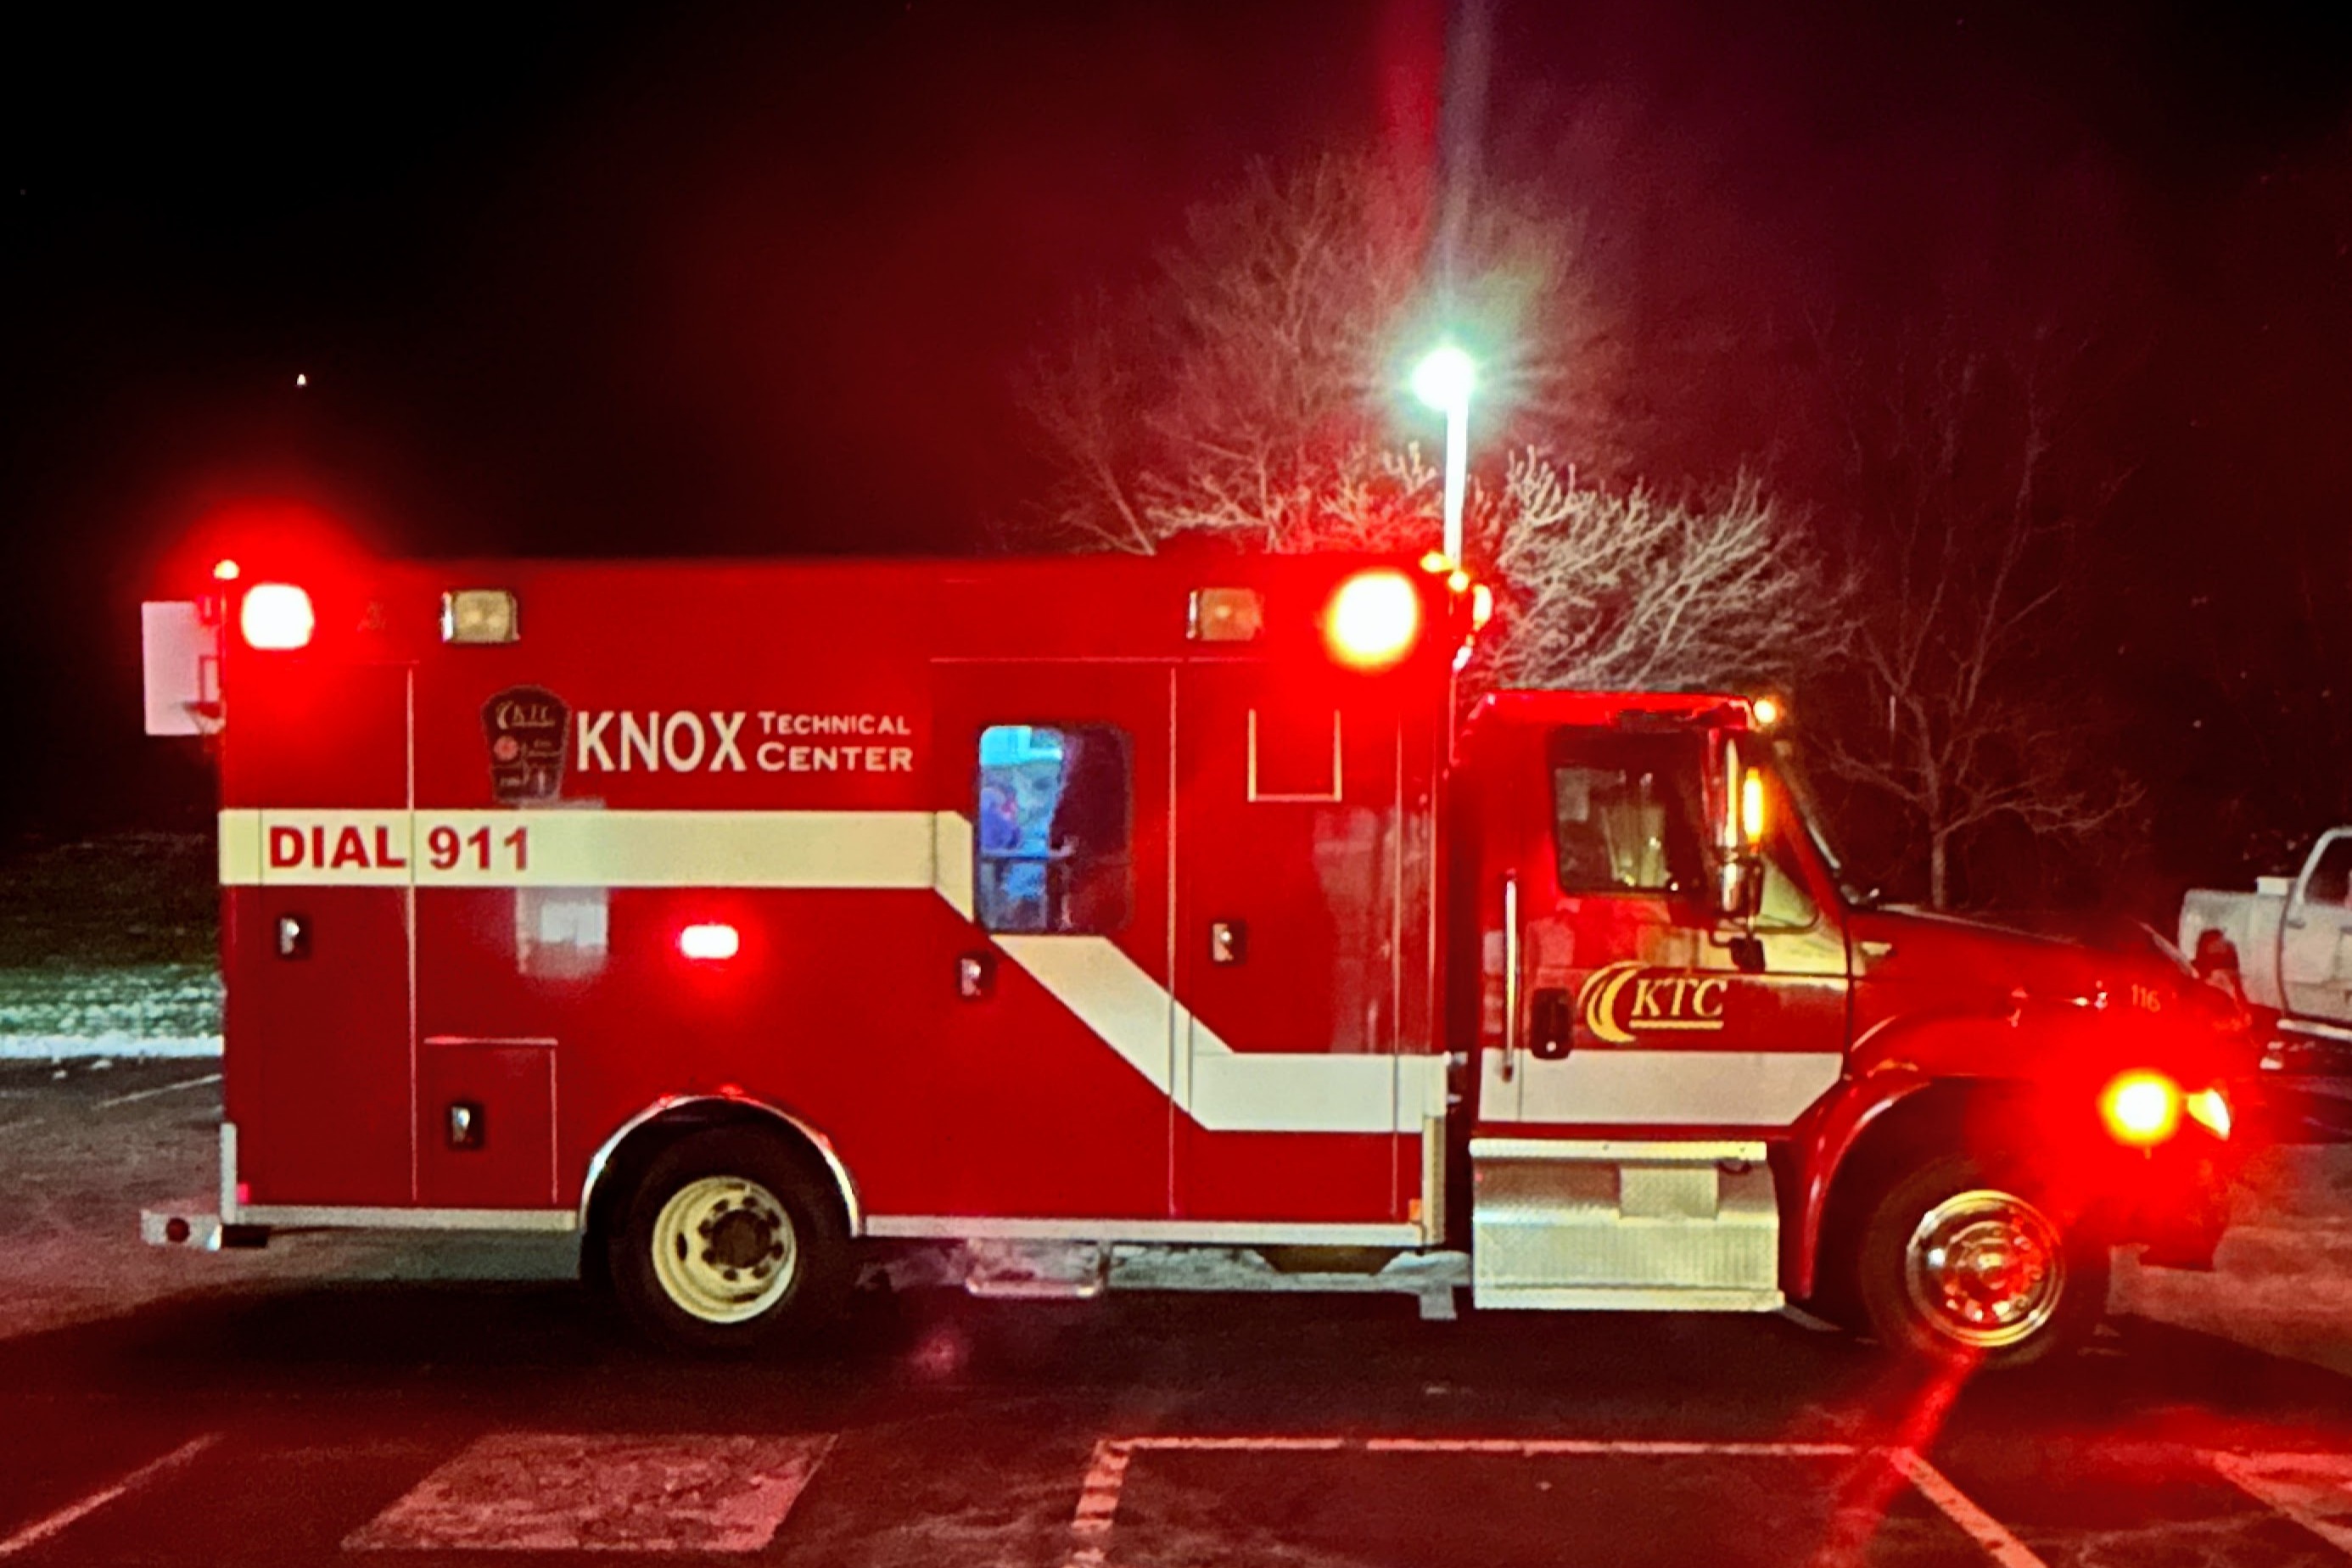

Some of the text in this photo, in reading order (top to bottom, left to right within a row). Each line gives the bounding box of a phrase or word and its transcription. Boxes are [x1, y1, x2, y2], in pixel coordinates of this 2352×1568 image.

[577, 710, 910, 772] KNOX TECHNICAL
[757, 742, 913, 772] CENTER
[269, 826, 528, 870] DIAL 911
[1630, 978, 1728, 1017] KTC
[2131, 983, 2161, 1012] 116
